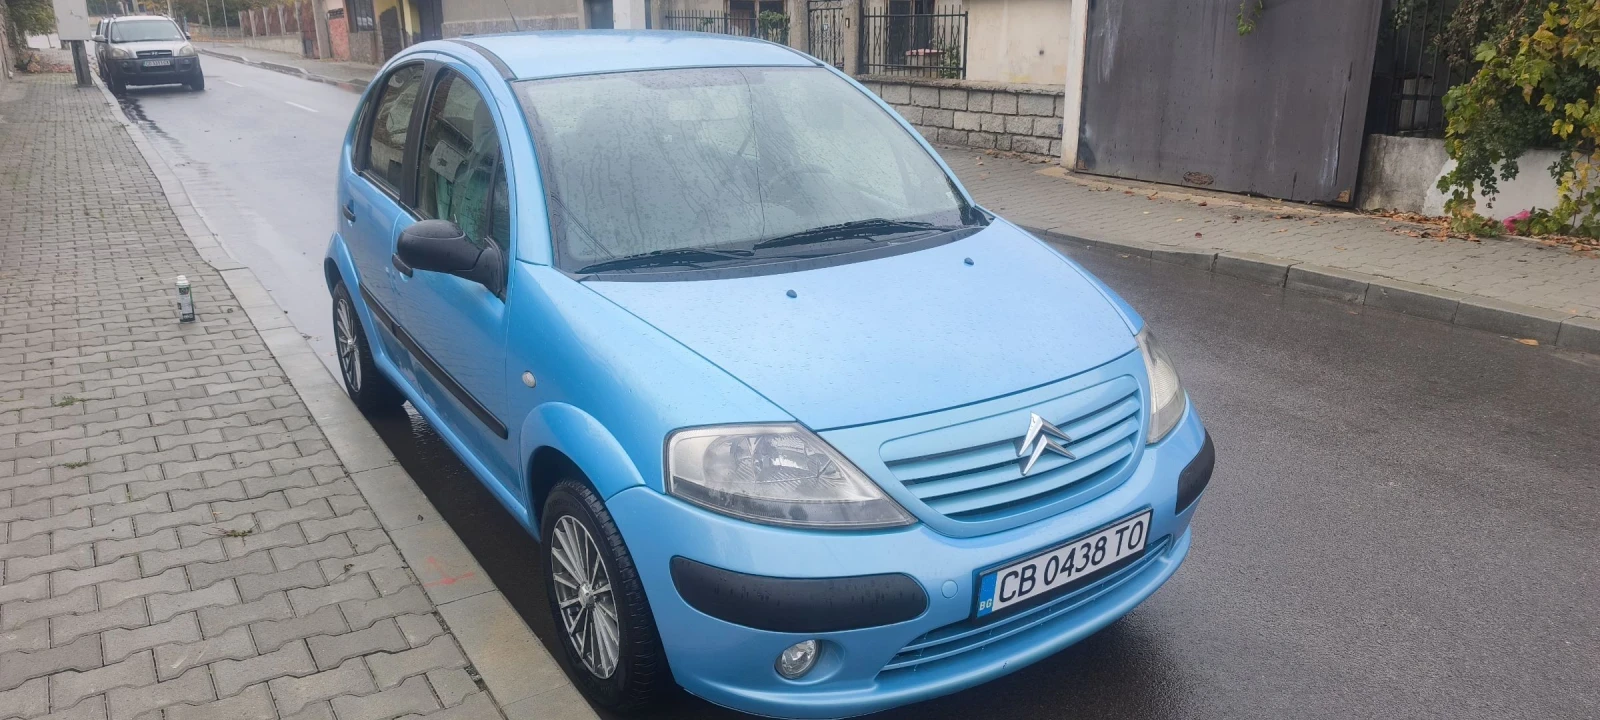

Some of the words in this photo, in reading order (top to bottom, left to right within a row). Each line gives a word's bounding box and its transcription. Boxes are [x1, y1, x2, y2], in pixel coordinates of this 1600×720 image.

[999, 564, 1037, 603] CB
[1043, 535, 1108, 586] 0438
[1115, 520, 1144, 557] TO
[979, 598, 993, 611] BG
